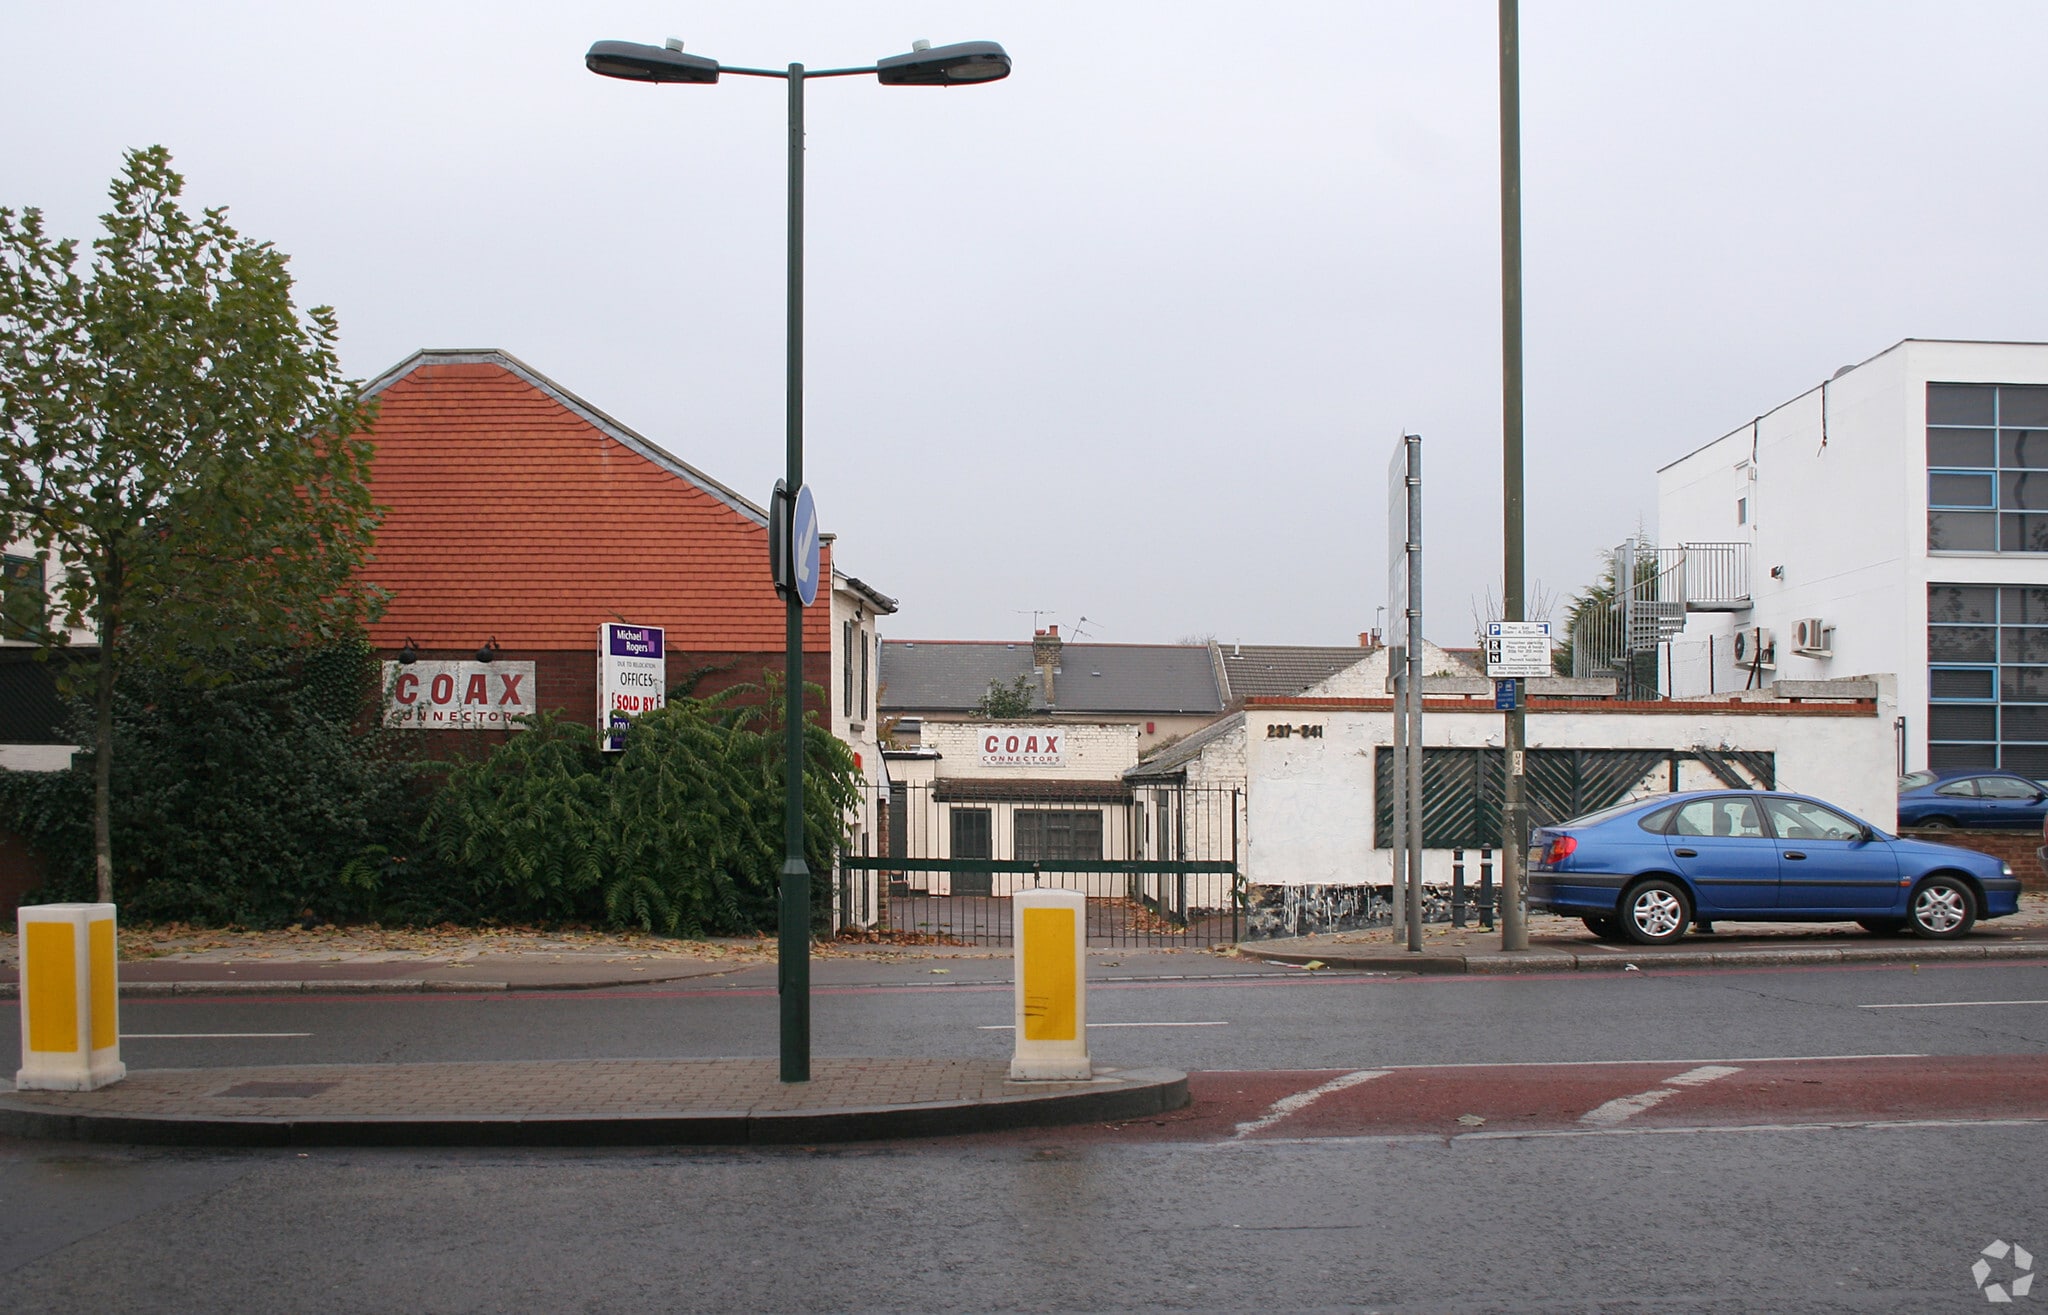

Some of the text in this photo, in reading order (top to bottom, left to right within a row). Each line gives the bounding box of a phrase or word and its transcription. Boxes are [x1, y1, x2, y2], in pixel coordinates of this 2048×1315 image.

[616, 629, 642, 641] Michael
[626, 641, 648, 655] Rogers
[620, 672, 653, 687] OFFICES
[394, 673, 524, 706] COAX
[617, 694, 639, 711] SOLD
[643, 697, 655, 712] BY
[984, 735, 1059, 754] COAX
